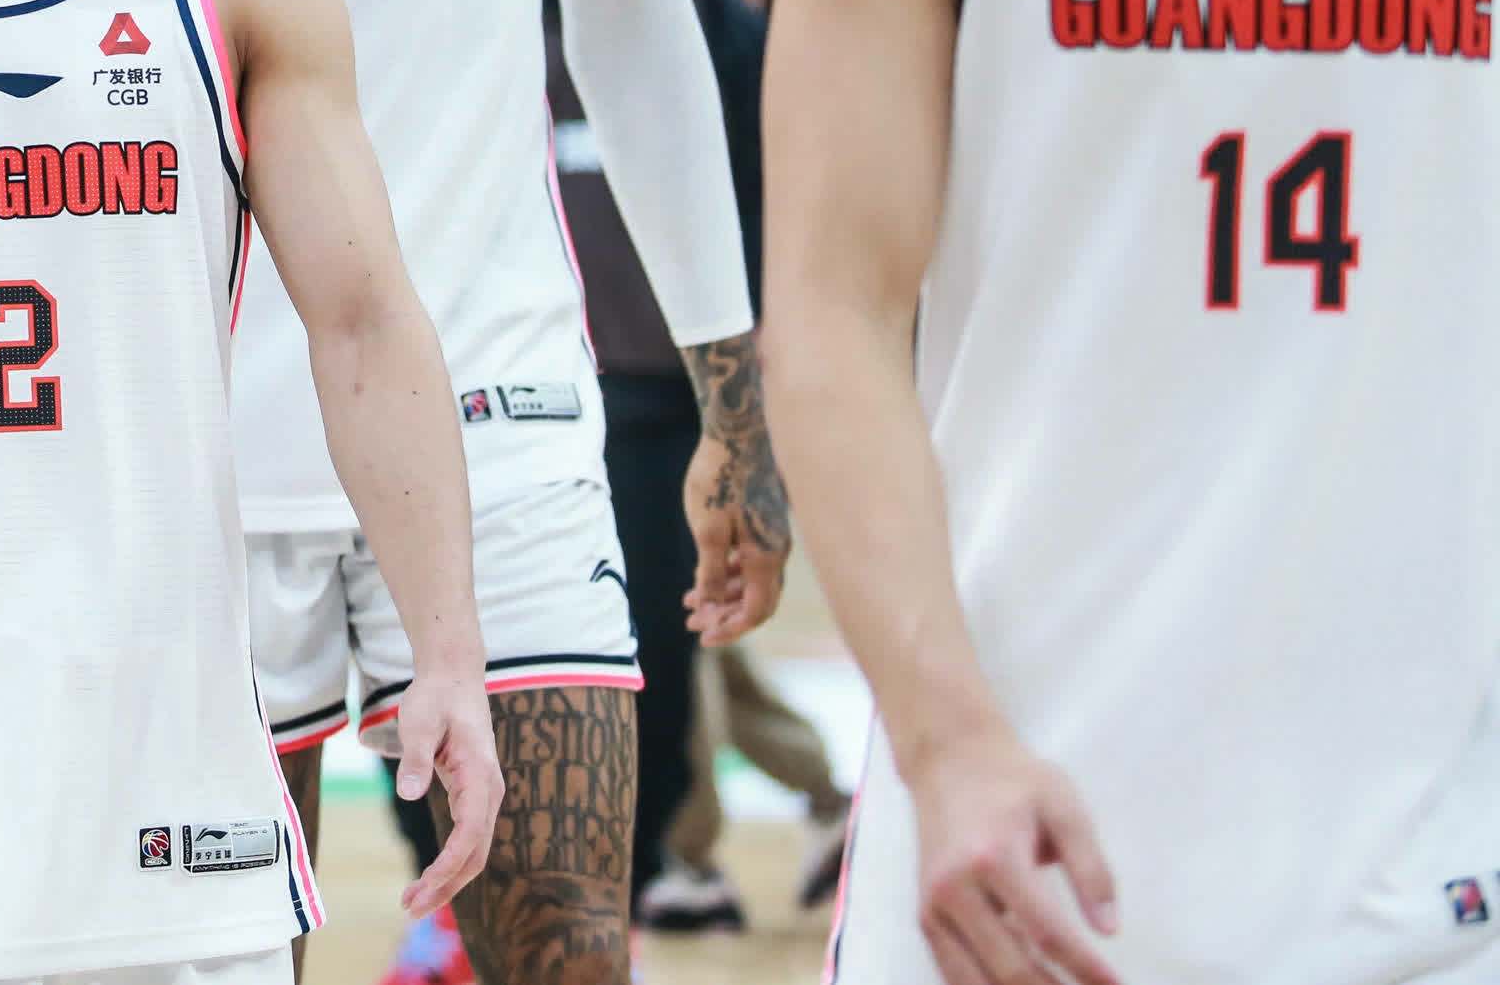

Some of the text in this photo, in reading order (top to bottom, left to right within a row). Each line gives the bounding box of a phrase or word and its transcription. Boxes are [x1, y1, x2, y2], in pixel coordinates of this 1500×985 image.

[92, 67, 162, 86] 广发银行
[106, 89, 150, 107] CGB
[1198, 130, 1361, 313] 14
